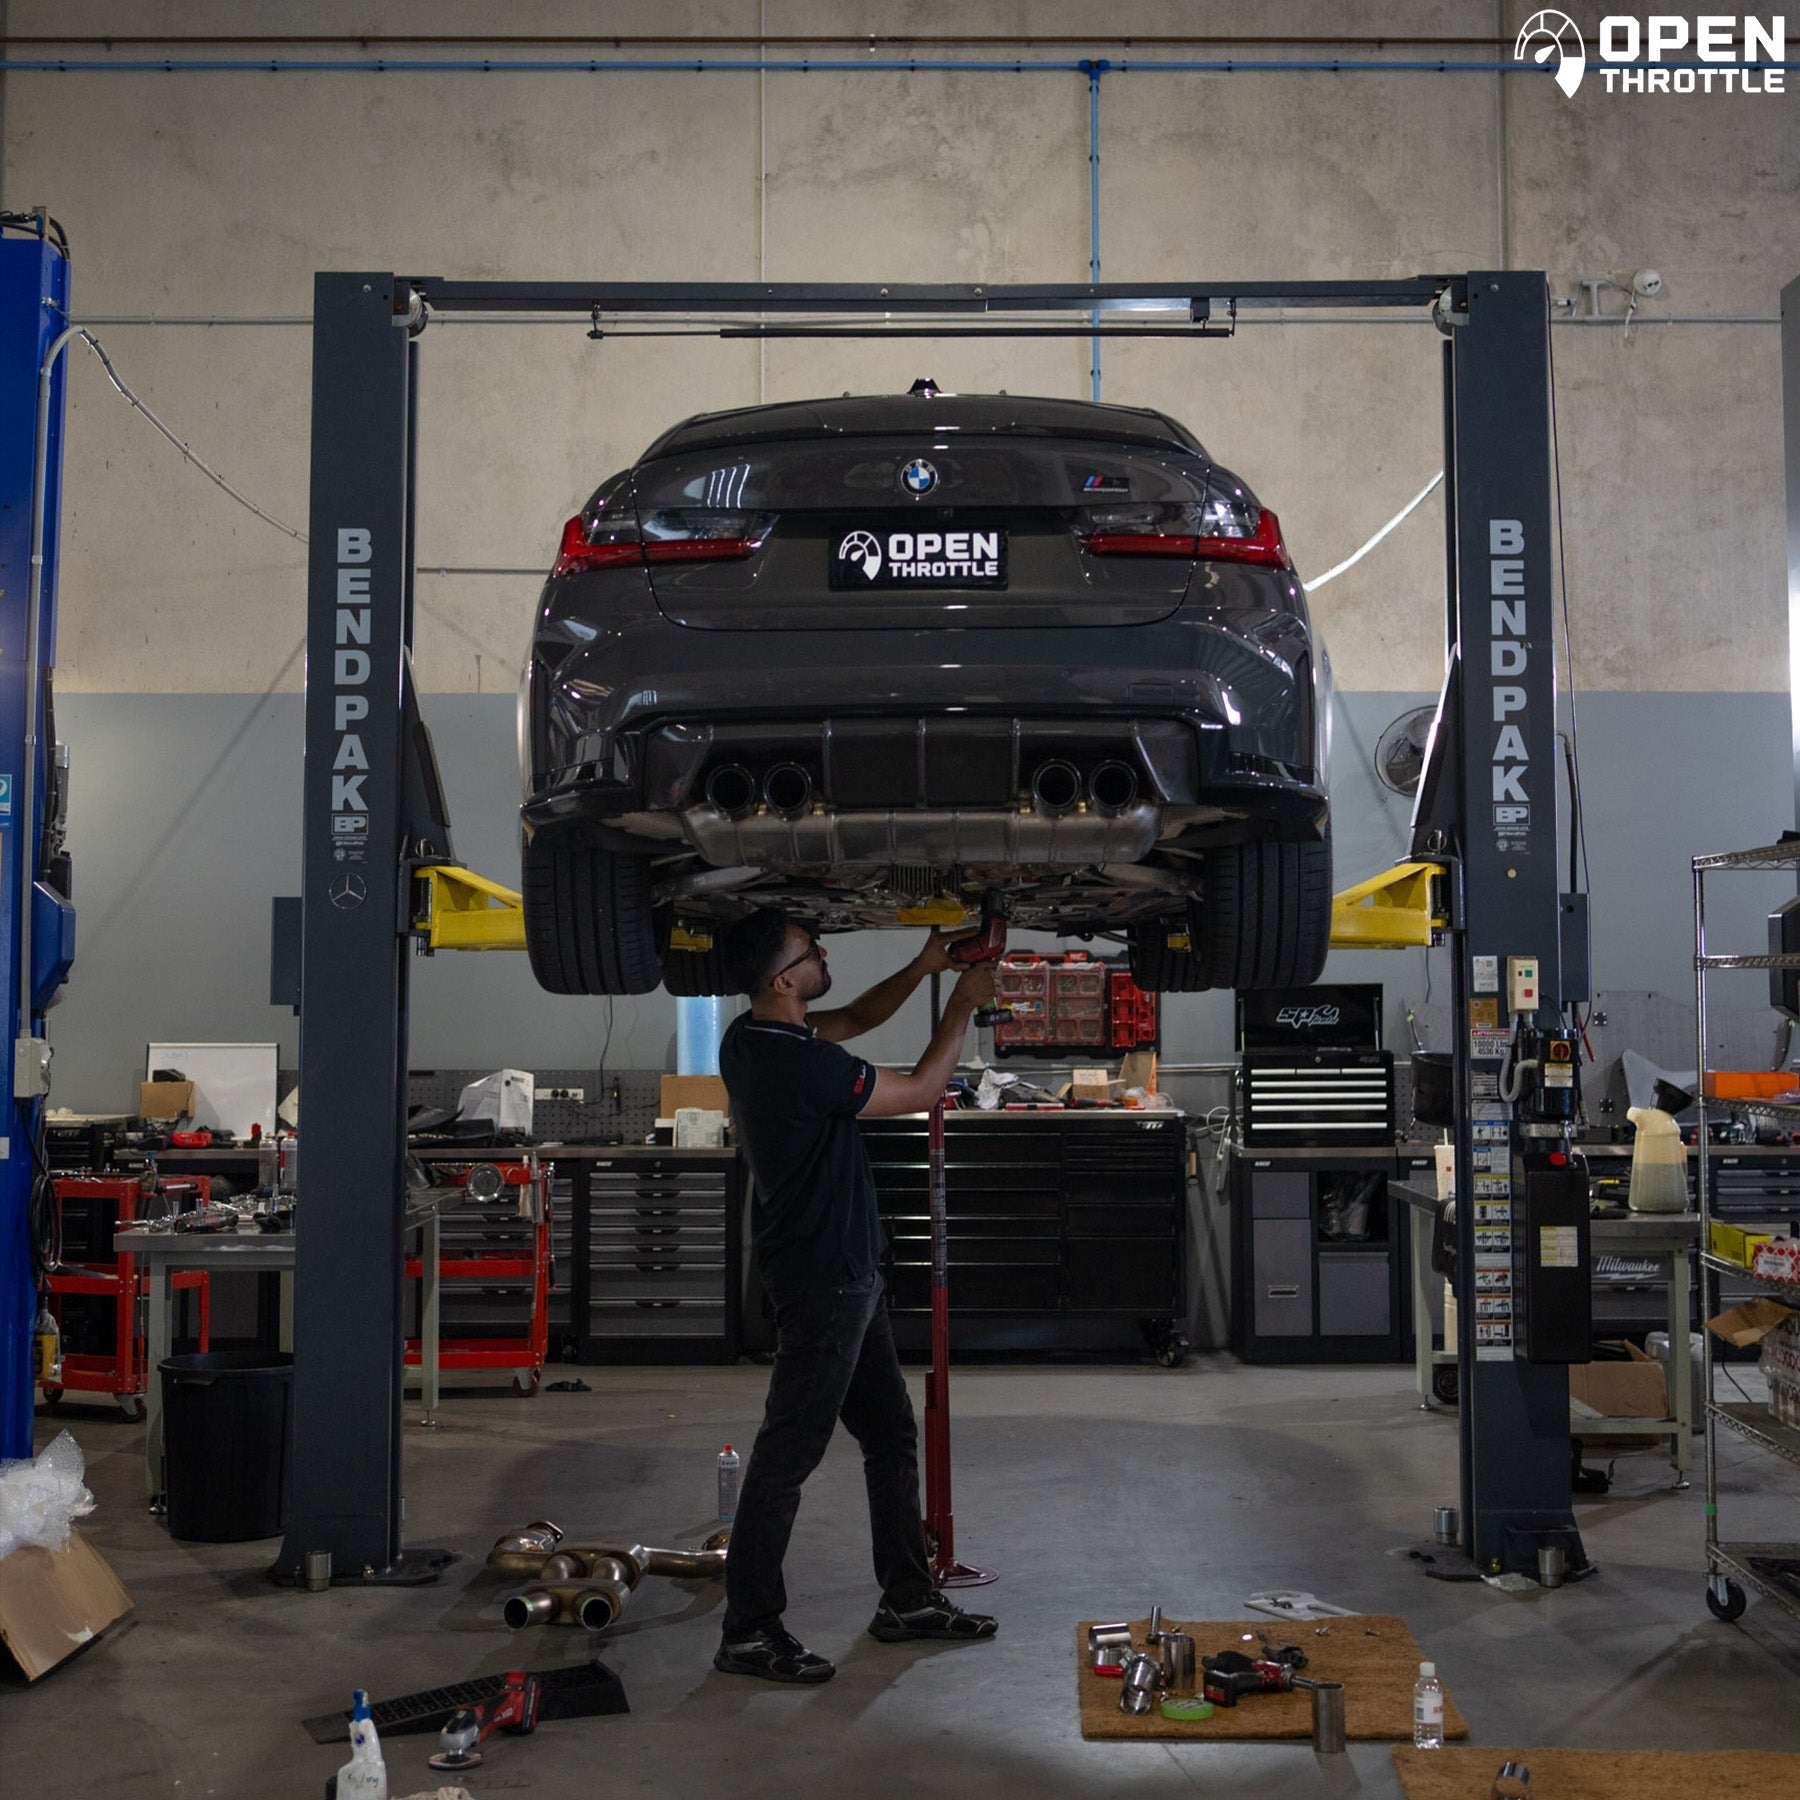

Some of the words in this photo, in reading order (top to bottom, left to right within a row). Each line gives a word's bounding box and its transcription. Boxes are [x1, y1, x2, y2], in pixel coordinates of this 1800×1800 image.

[888, 532, 998, 560] OPEN
[888, 561, 998, 577] THROTTLE
[331, 528, 373, 811] BENDPAK
[1489, 519, 1530, 801] BENDPAK
[334, 816, 366, 833] BP
[1496, 807, 1528, 823] BP
